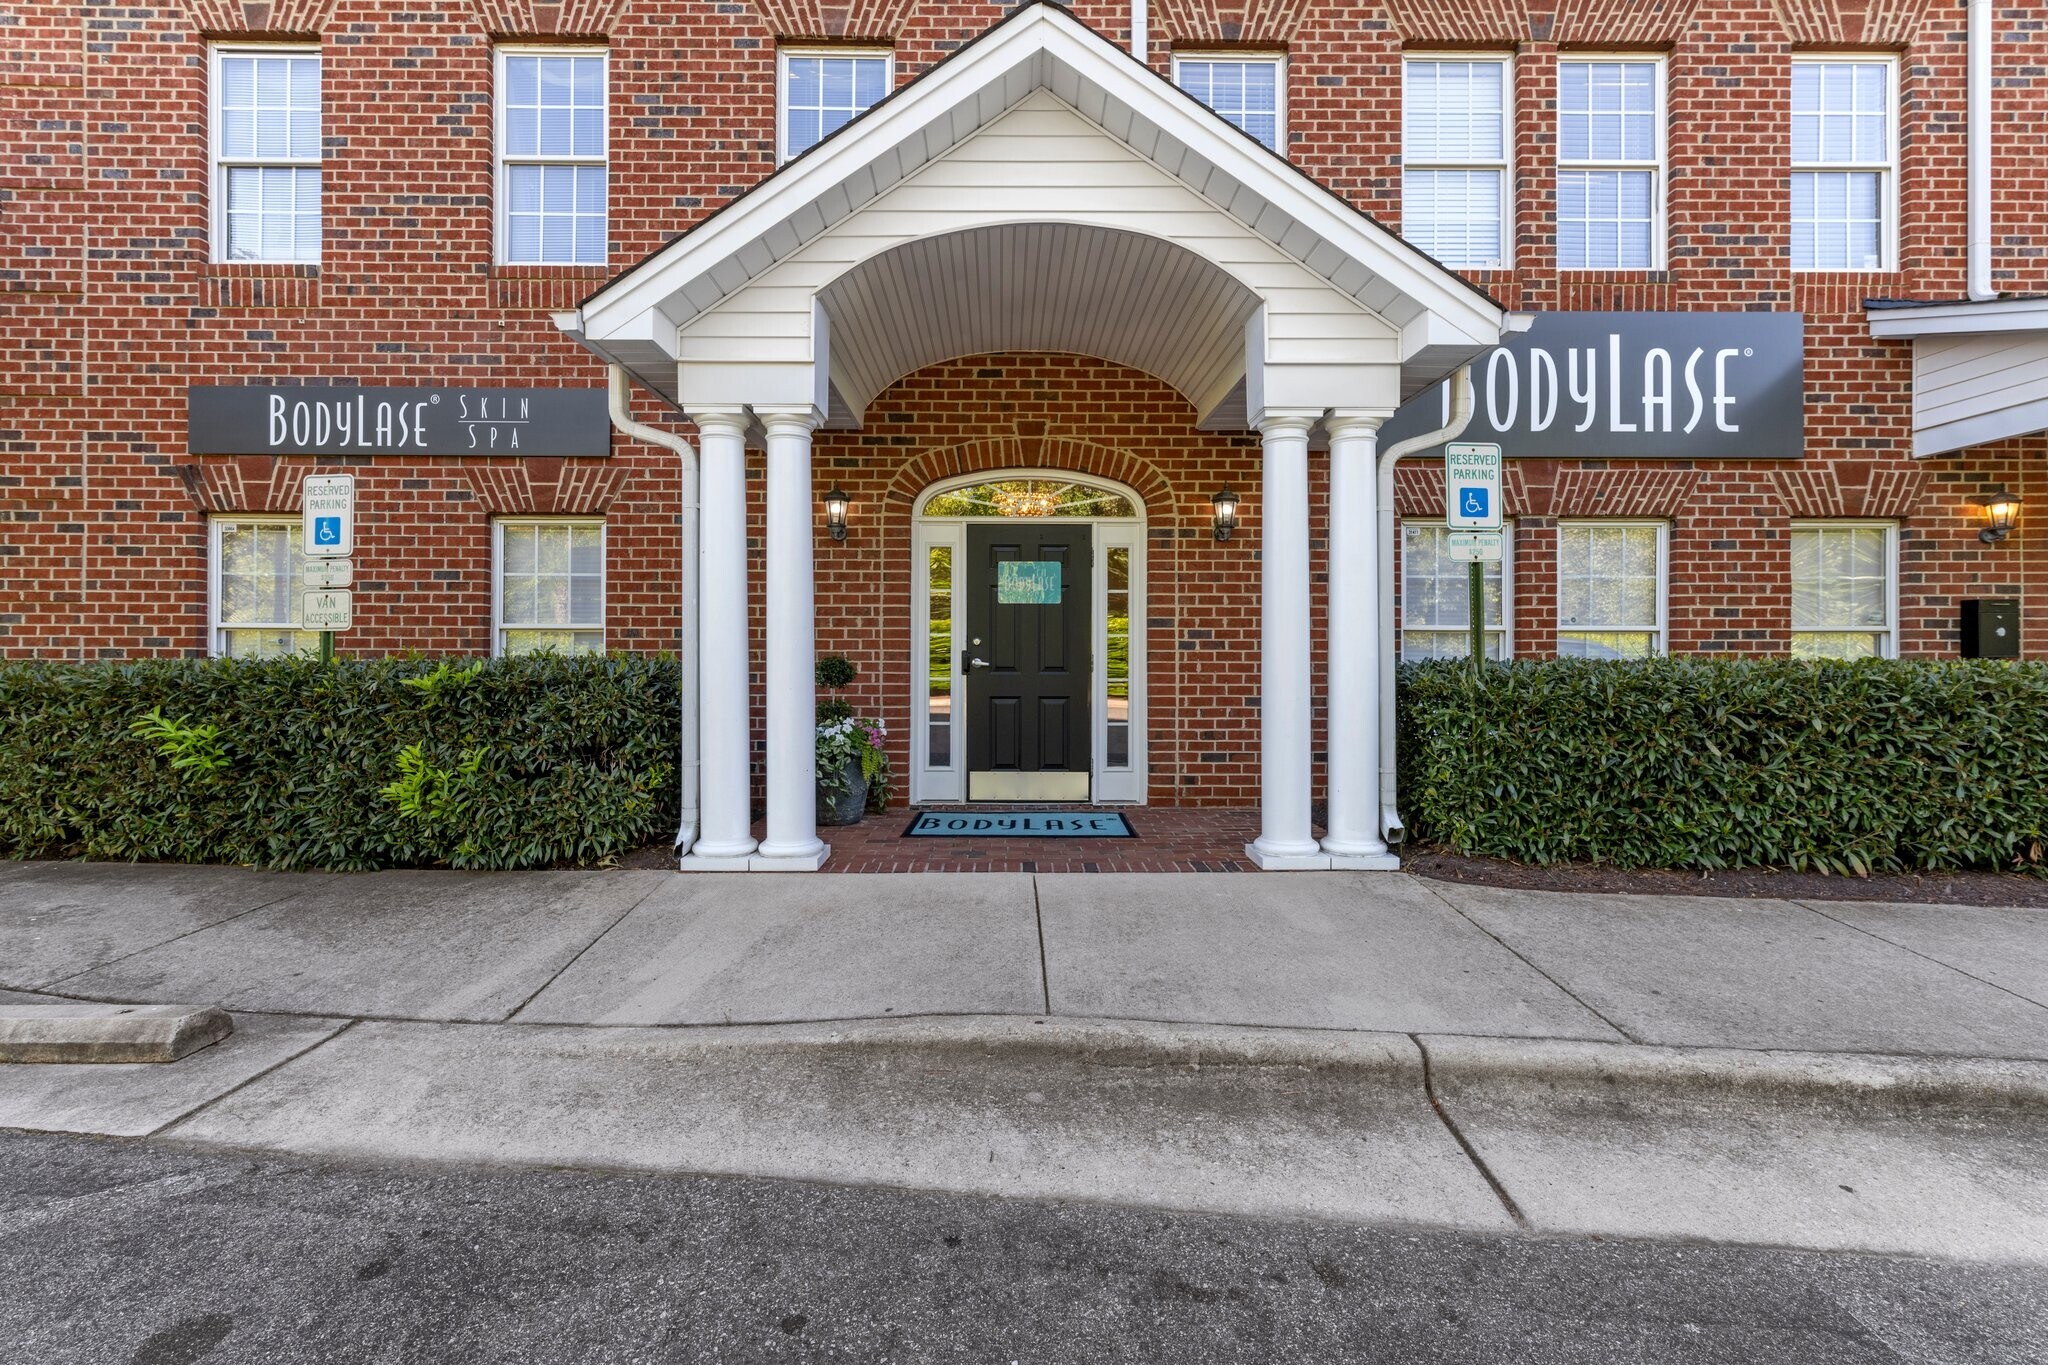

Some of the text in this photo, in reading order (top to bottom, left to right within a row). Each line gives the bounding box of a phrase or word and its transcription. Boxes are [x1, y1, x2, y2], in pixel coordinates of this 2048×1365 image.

[459, 394, 529, 419] SKIN
[468, 424, 519, 449] SPA
[1450, 454, 1498, 466] RESERVED
[1453, 468, 1495, 481] PARKING
[307, 485, 350, 497] RESERVED
[309, 499, 348, 510] PARKING
[1451, 539, 1500, 547] MAXIMUM PENALTY
[305, 564, 349, 573] MAXIMUM PENALTY
[316, 597, 336, 609] VAN
[304, 612, 348, 624] ACCESSIBLE
